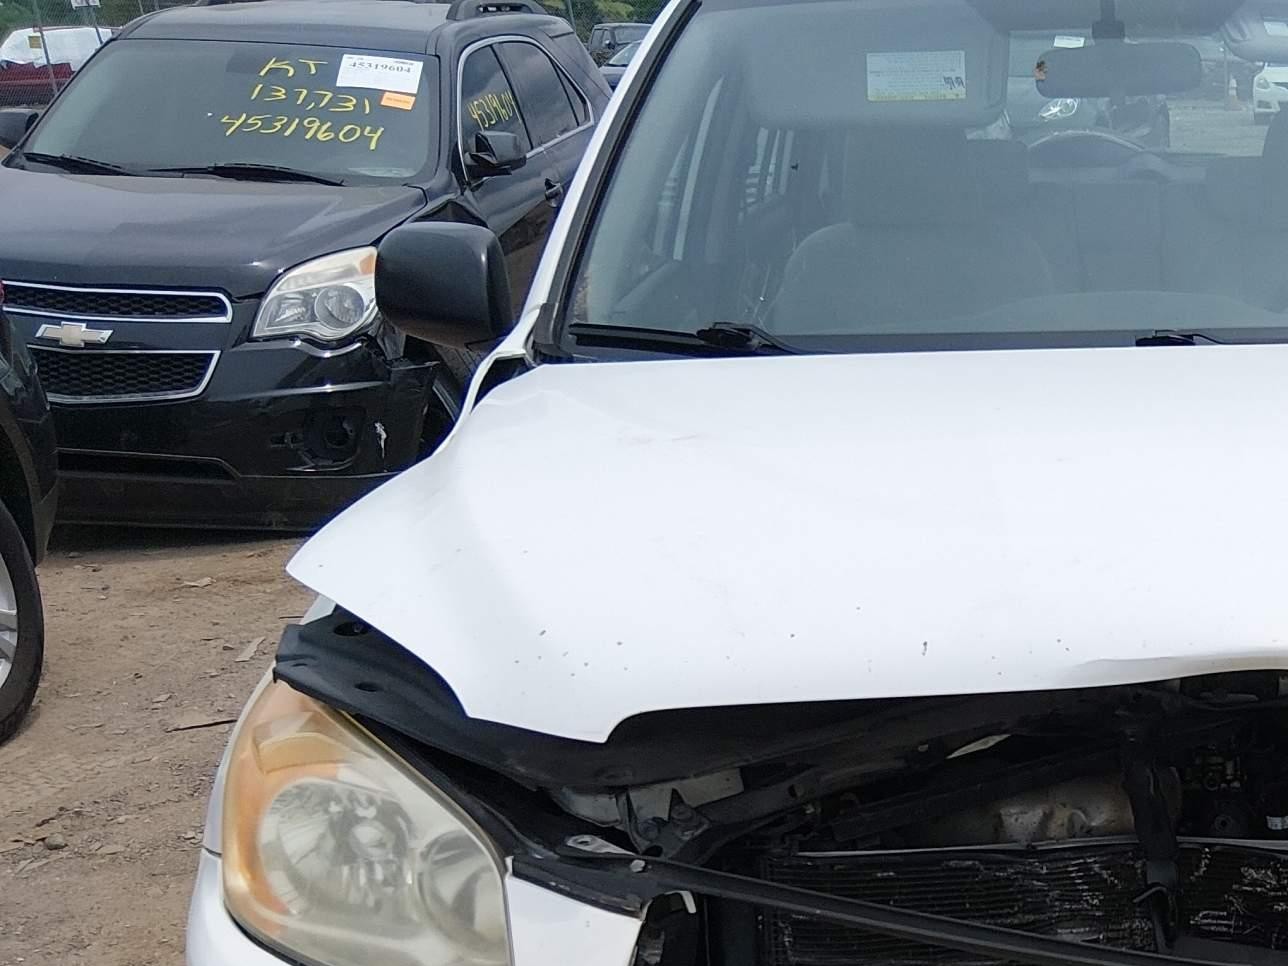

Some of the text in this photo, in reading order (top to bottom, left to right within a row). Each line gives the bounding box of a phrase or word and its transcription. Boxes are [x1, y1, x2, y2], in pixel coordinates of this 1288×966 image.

[348, 61, 412, 73] 45319604
[250, 84, 370, 114] 137,731
[221, 113, 385, 150] 45319604
